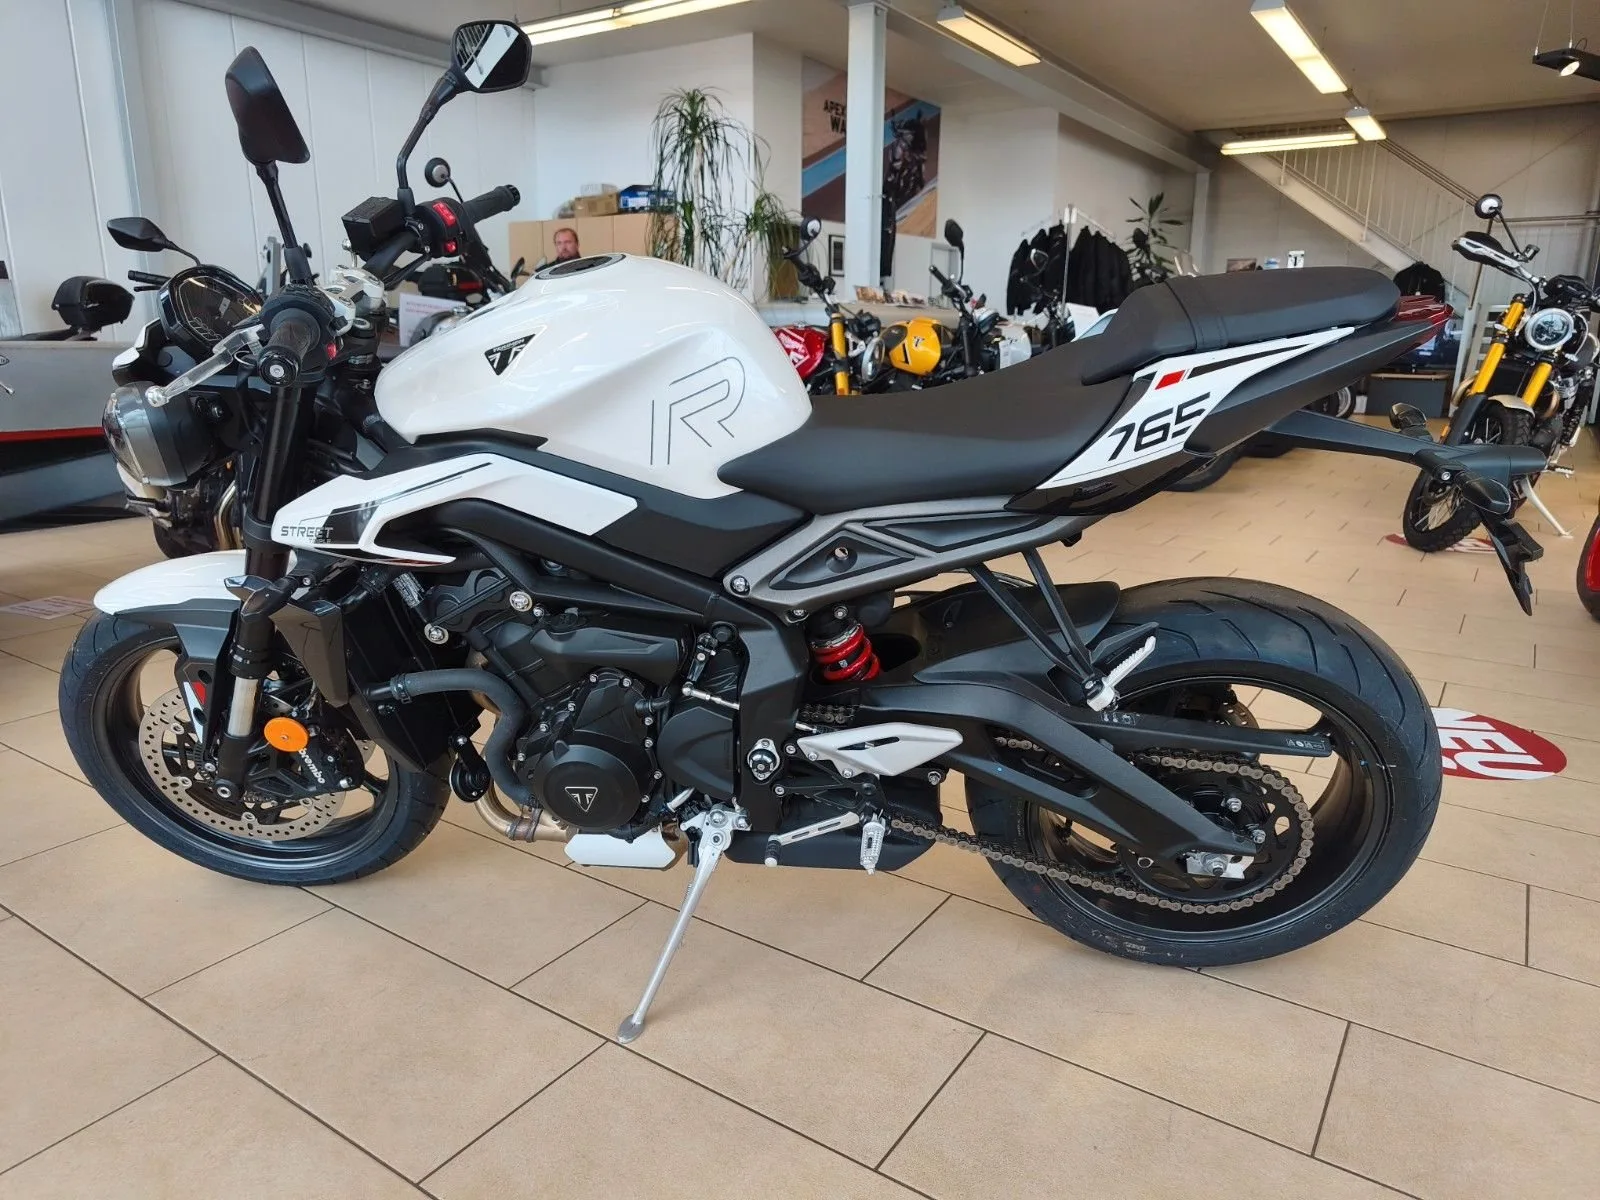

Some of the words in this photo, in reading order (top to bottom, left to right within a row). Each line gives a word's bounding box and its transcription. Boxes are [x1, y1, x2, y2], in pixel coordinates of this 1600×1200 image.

[650, 356, 746, 465] R
[1107, 391, 1211, 462] 765
[280, 525, 334, 538] STREET
[298, 747, 326, 784] brembo
